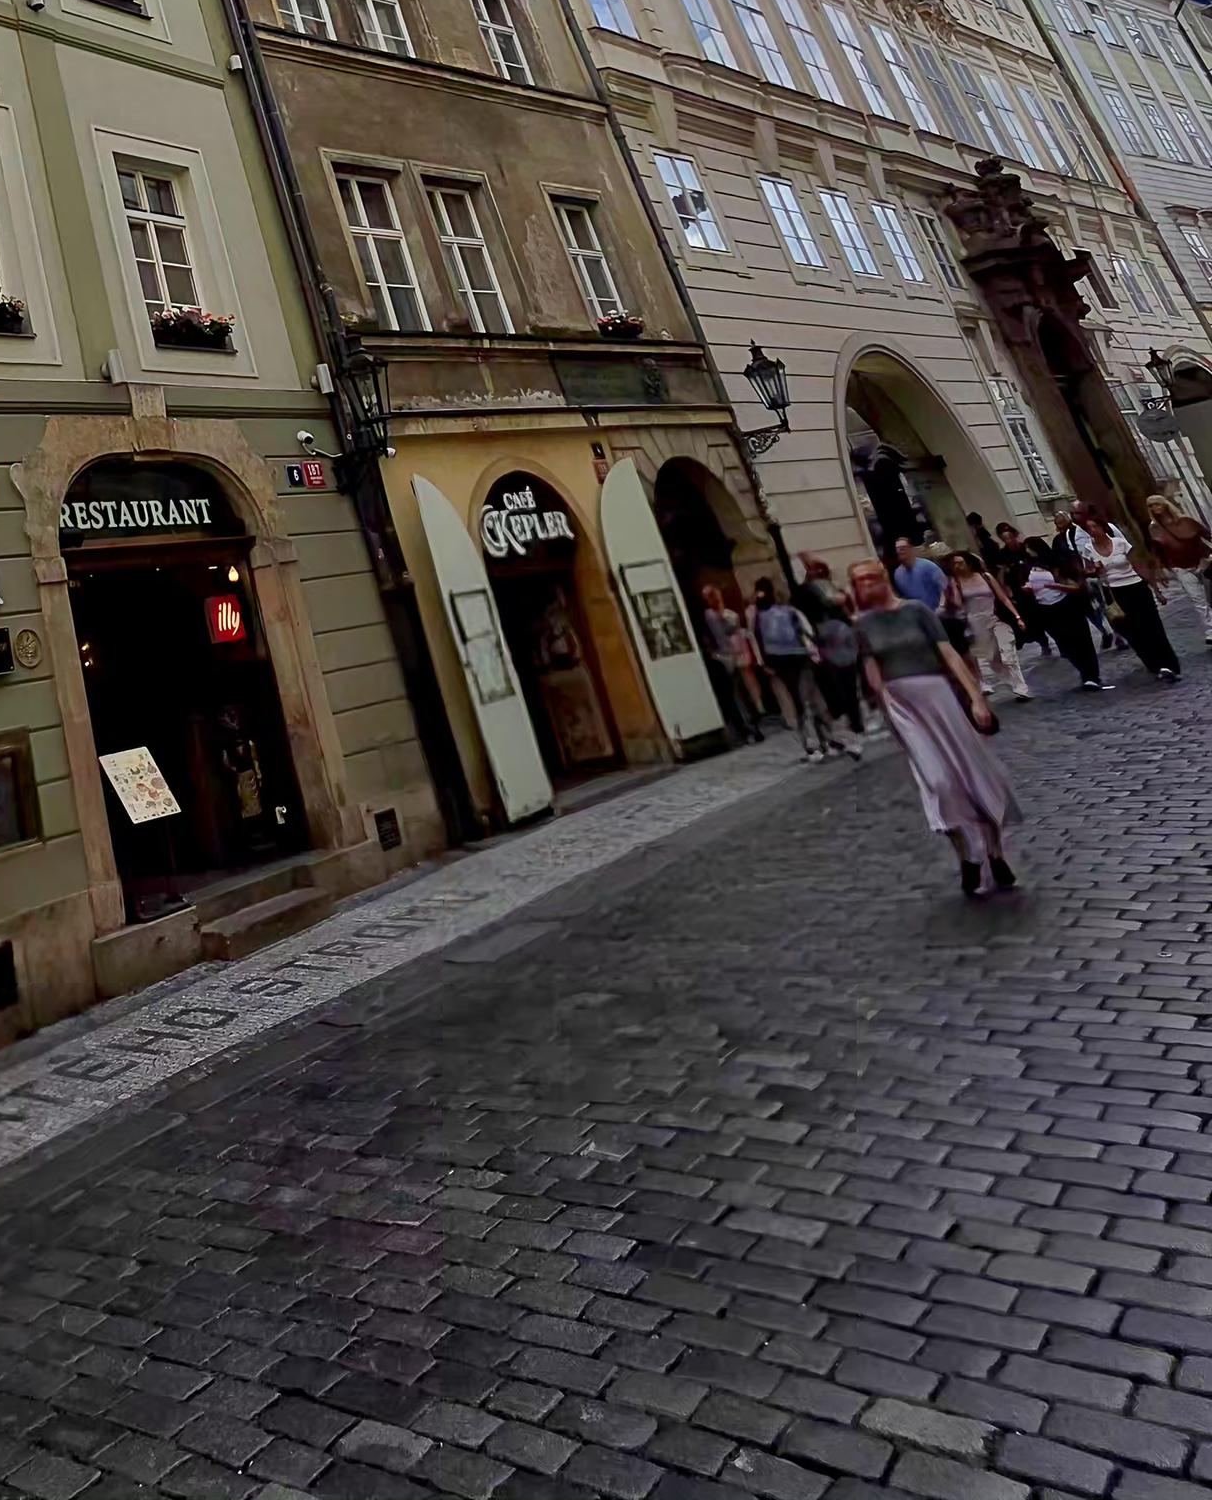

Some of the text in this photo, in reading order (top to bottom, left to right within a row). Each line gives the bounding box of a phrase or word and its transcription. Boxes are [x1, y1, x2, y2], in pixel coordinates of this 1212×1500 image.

[293, 469, 299, 481] 6
[502, 485, 537, 510] CAFÉ
[59, 499, 212, 530] RESTAURANT
[218, 602, 240, 636] illy
